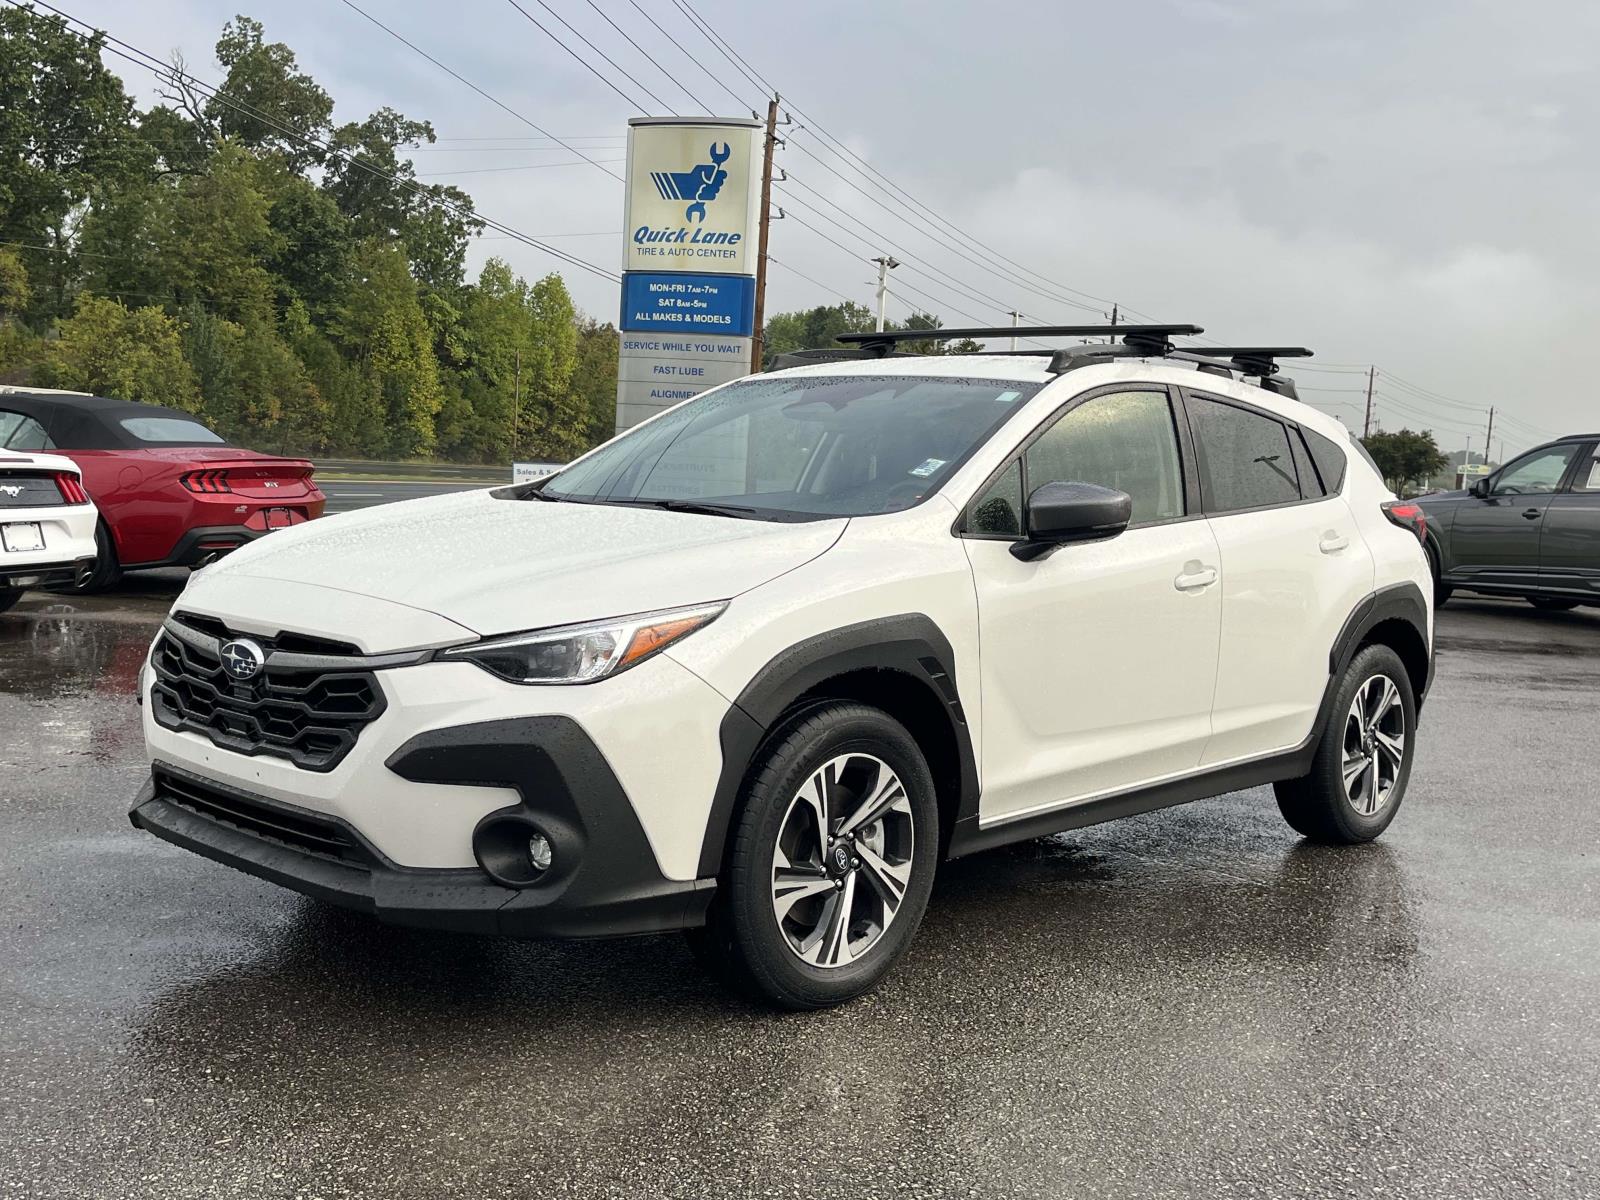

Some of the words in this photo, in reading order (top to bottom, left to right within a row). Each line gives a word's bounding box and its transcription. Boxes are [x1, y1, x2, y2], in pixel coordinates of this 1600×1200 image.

[634, 226, 690, 244] Quick
[690, 228, 742, 245] Lane
[637, 247, 657, 256] TIRE
[658, 248, 665, 256] &
[667, 248, 694, 257] AUTO
[696, 248, 737, 259] CENTER
[649, 283, 686, 293] MON-FRI
[658, 298, 676, 307] SAT
[635, 312, 651, 321] ALL
[652, 313, 683, 322] MAKES
[684, 313, 692, 322] &
[693, 314, 732, 324] MODELS
[623, 341, 660, 350] SERVICE
[662, 342, 692, 352] WHILE
[694, 343, 715, 353] YOU
[717, 344, 742, 354] WAIT
[653, 365, 677, 376] FAST
[679, 367, 705, 377] LUBE
[516, 468, 537, 476] Sales
